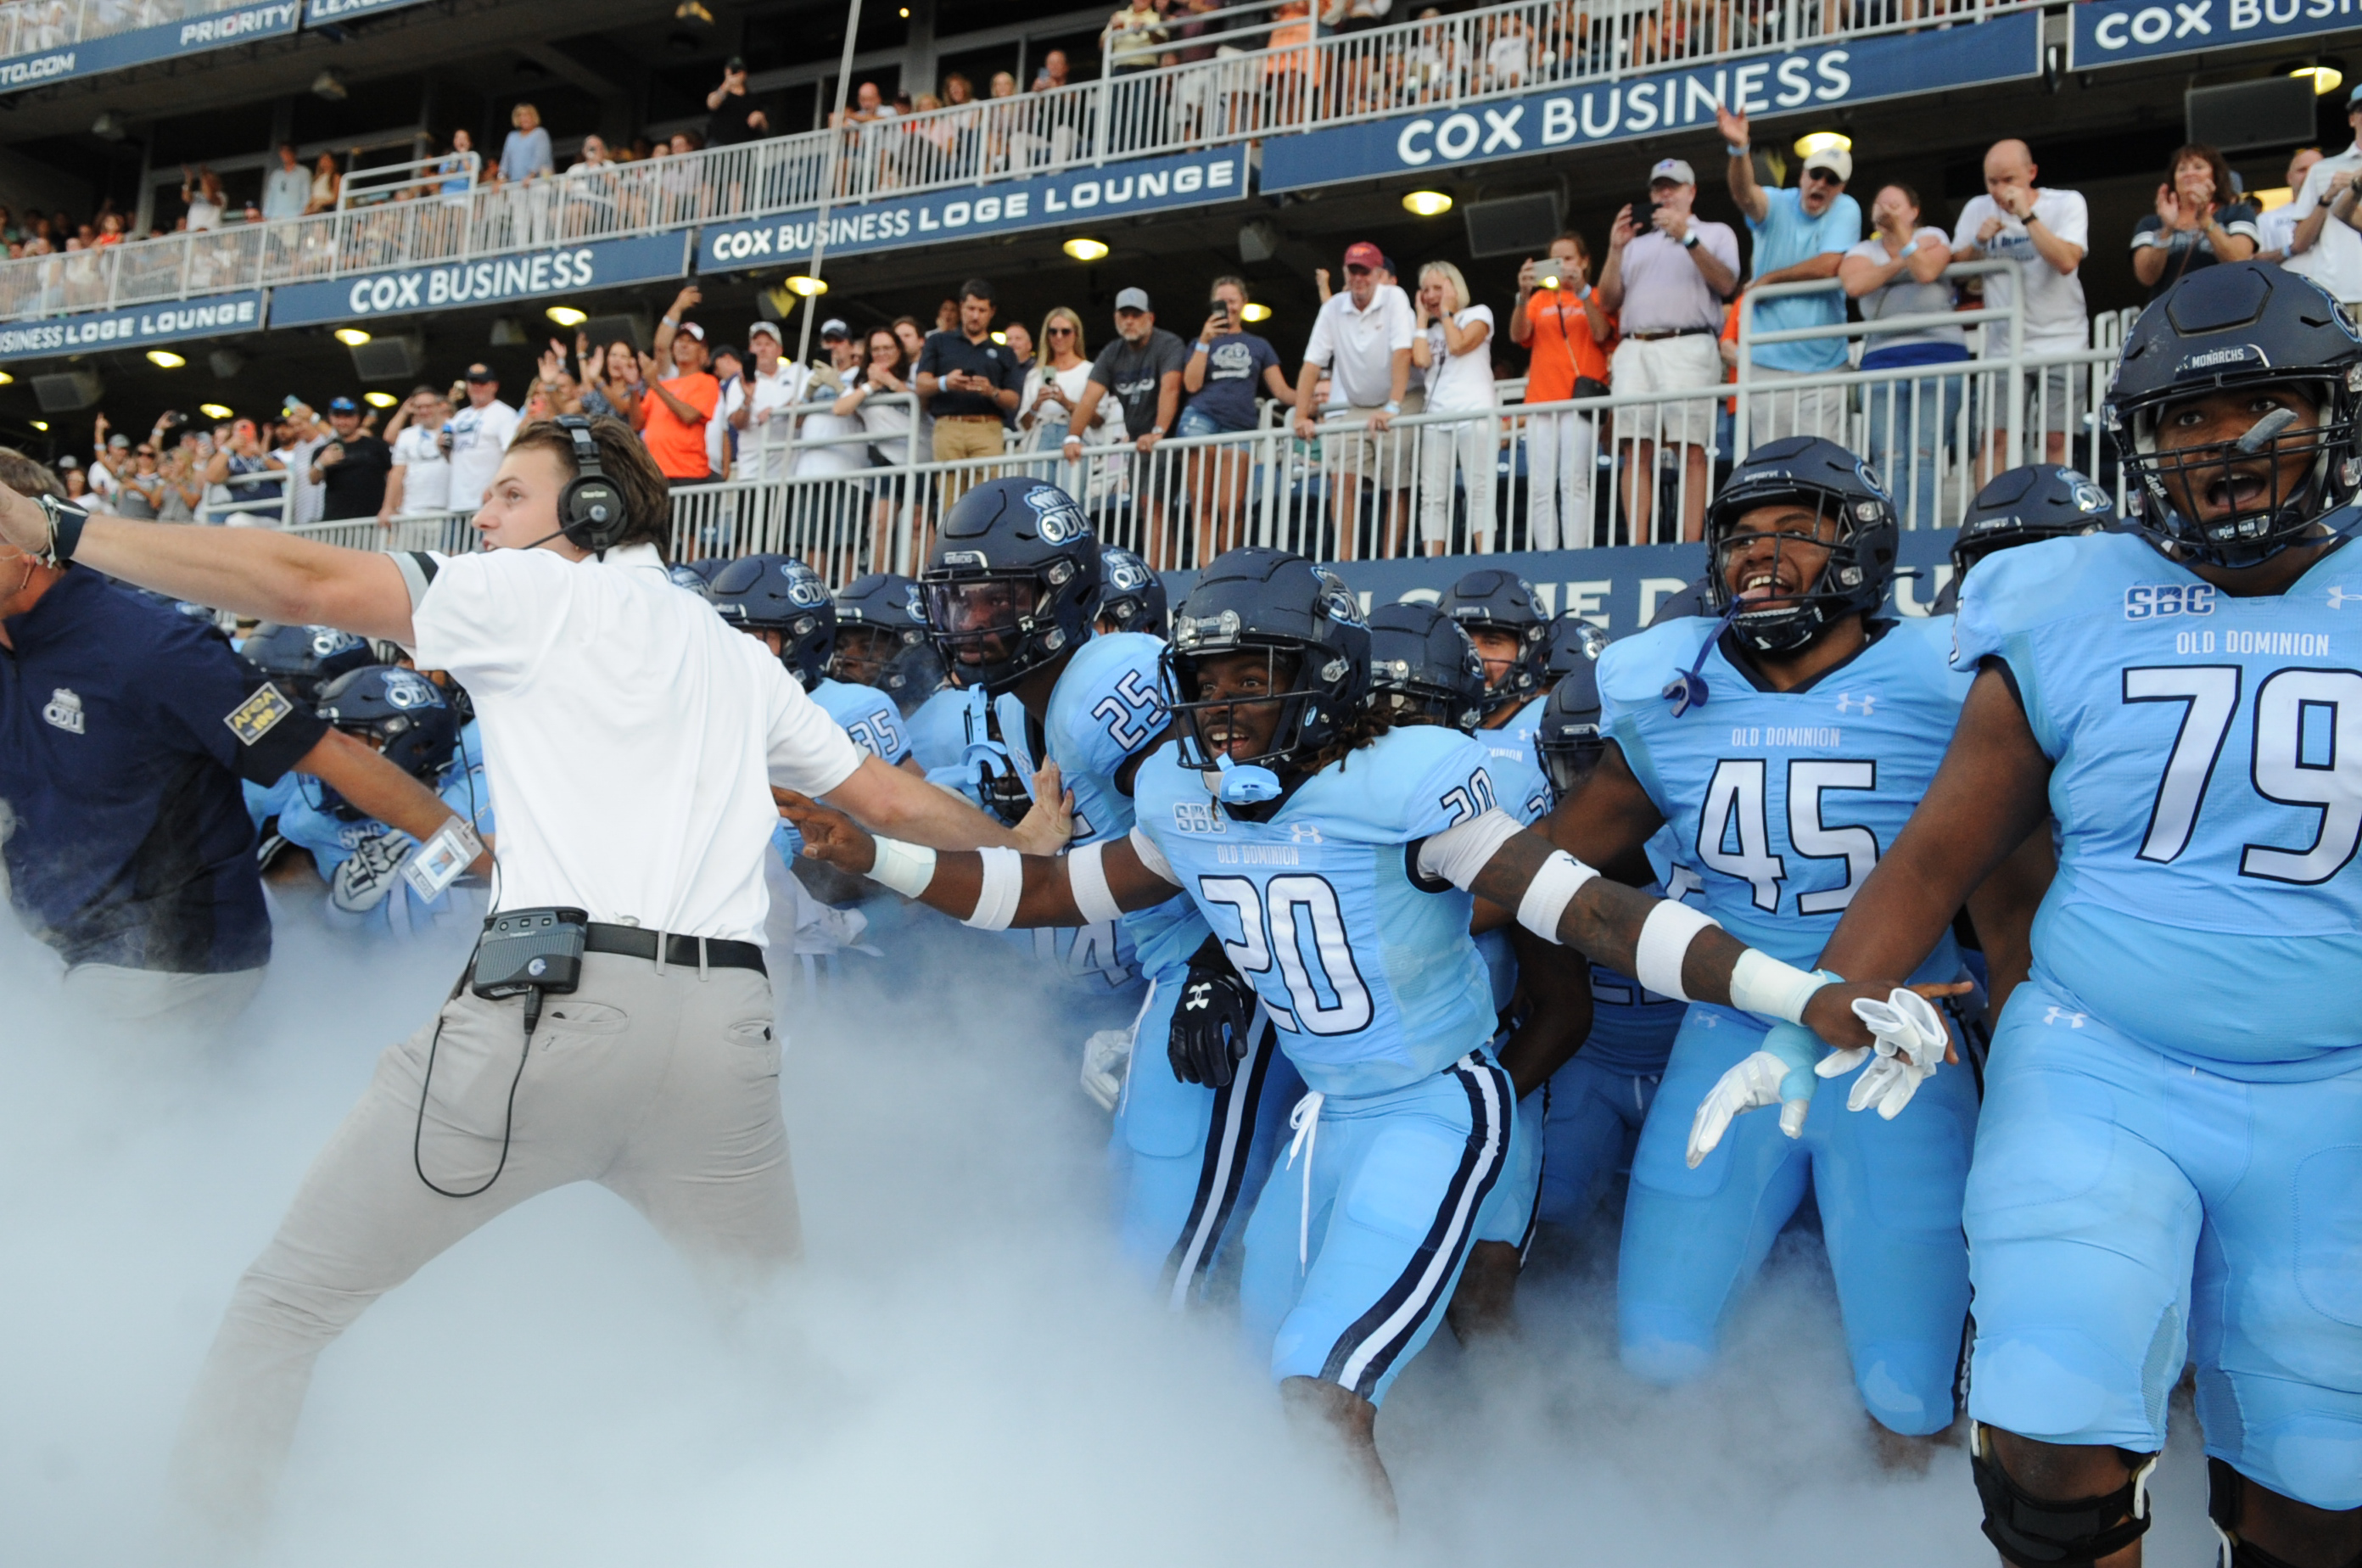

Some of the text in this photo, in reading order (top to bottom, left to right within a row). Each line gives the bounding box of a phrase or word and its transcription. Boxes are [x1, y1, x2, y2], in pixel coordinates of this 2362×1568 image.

[180, 2, 295, 46] PRIORITY
[2096, 0, 2212, 49] COX
[1397, 50, 1850, 165] COX BUSINESS
[713, 160, 1234, 260] COX BUSINESS LOGE LOUNGE
[350, 249, 594, 314] COX BUSINESS
[65, 317, 134, 344] LOGE
[141, 300, 255, 335] LOUNGE
[2191, 348, 2244, 368] MONARCHS
[1040, 507, 1093, 542] ODU
[2124, 582, 2215, 621] SBC
[2176, 630, 2329, 657] OLD DOMINION
[389, 682, 440, 707] ODU
[1091, 669, 1170, 752] 25
[42, 703, 85, 735] ODU
[1732, 727, 1840, 748] OLD DOMINION
[2122, 664, 2362, 885] 79
[1173, 802, 1227, 834] SBC
[1695, 759, 1880, 916] 45
[1217, 845, 1299, 865] OLD DOMINION
[1198, 873, 1374, 1037] 20
